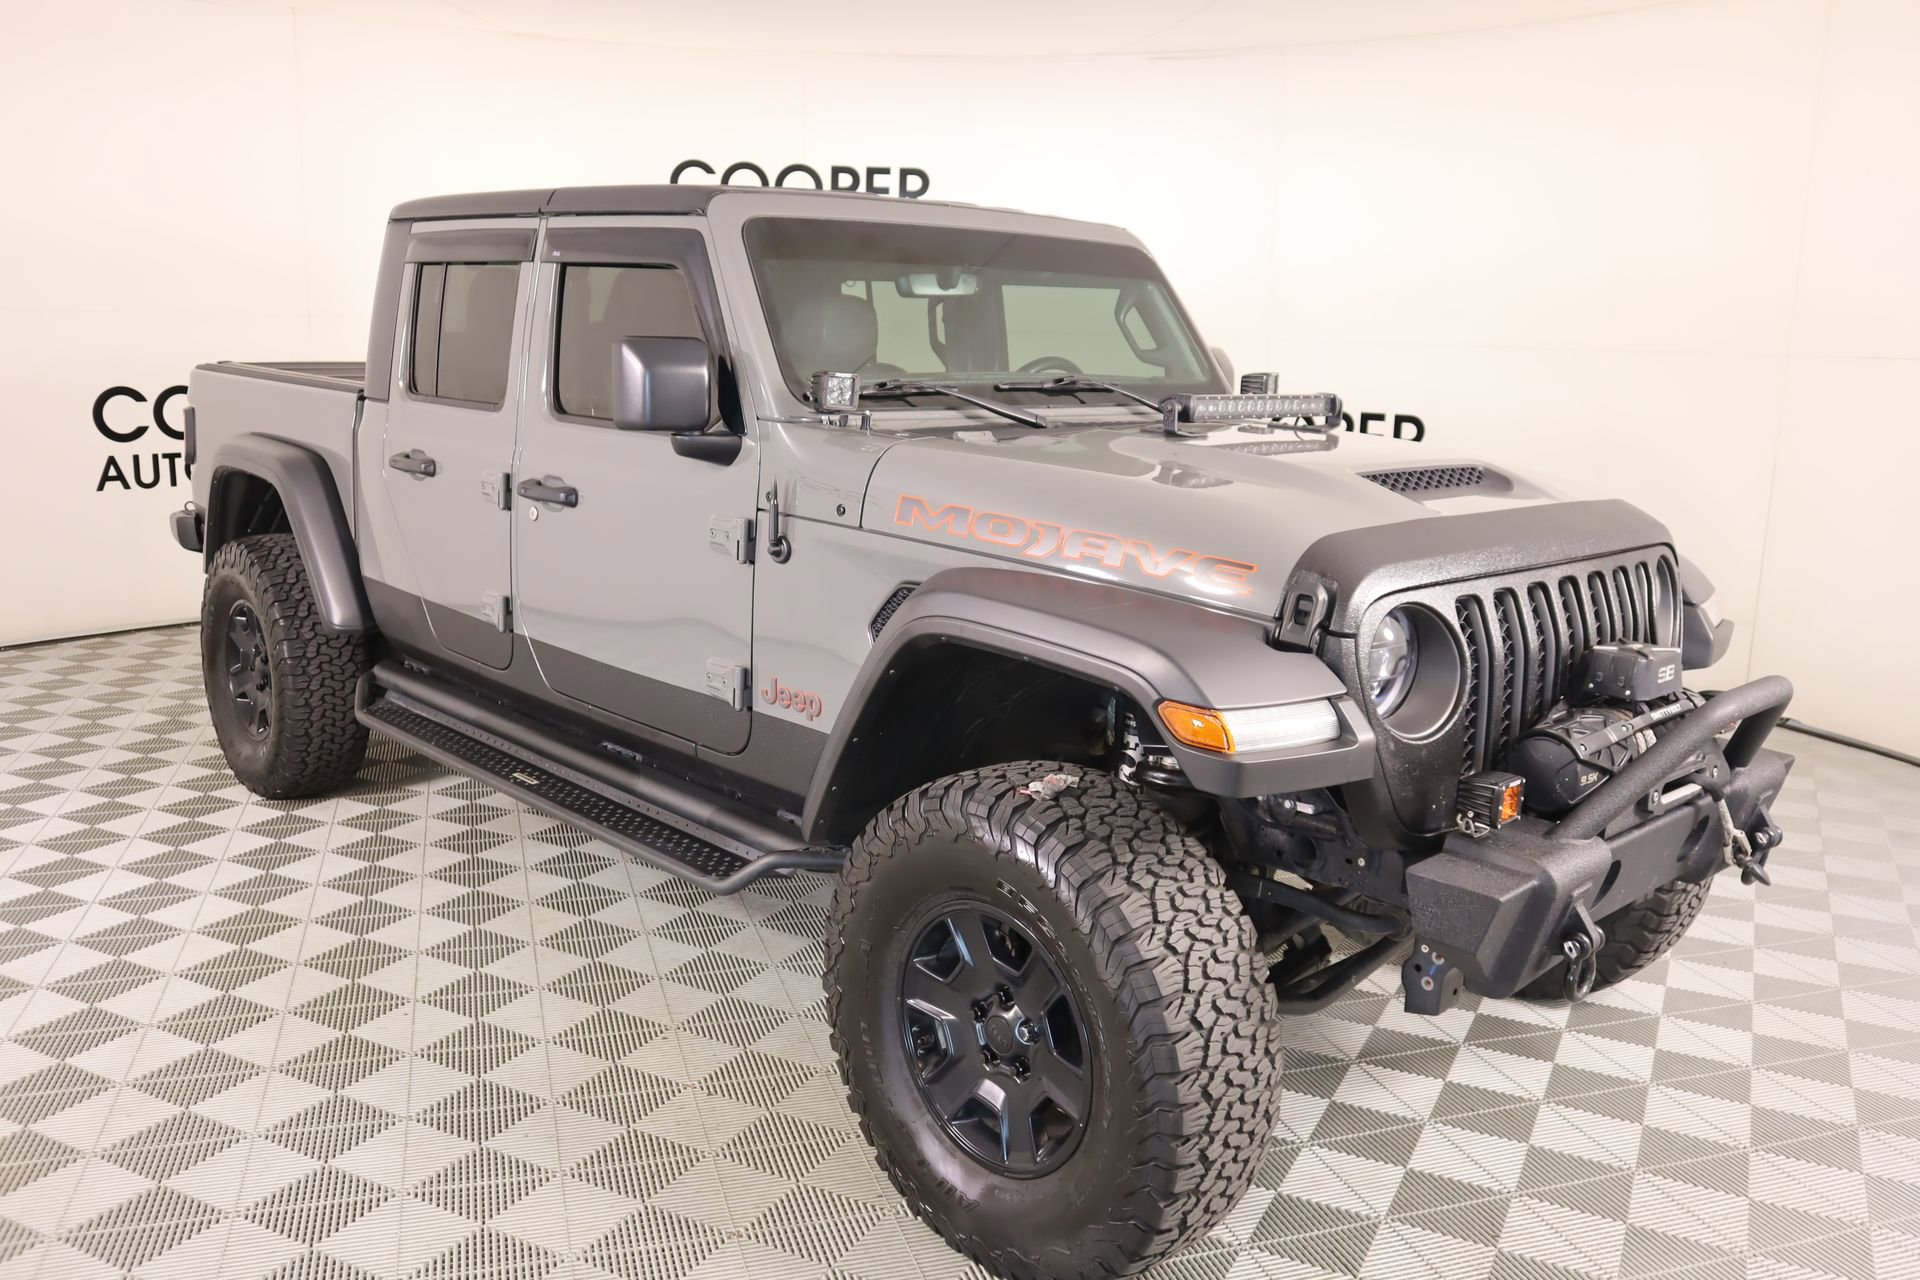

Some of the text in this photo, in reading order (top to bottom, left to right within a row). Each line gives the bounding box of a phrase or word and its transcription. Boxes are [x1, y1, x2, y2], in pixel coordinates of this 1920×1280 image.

[96, 452, 191, 491] AUT
[894, 493, 1260, 598] MOJAVE
[761, 675, 822, 721] Jeep
